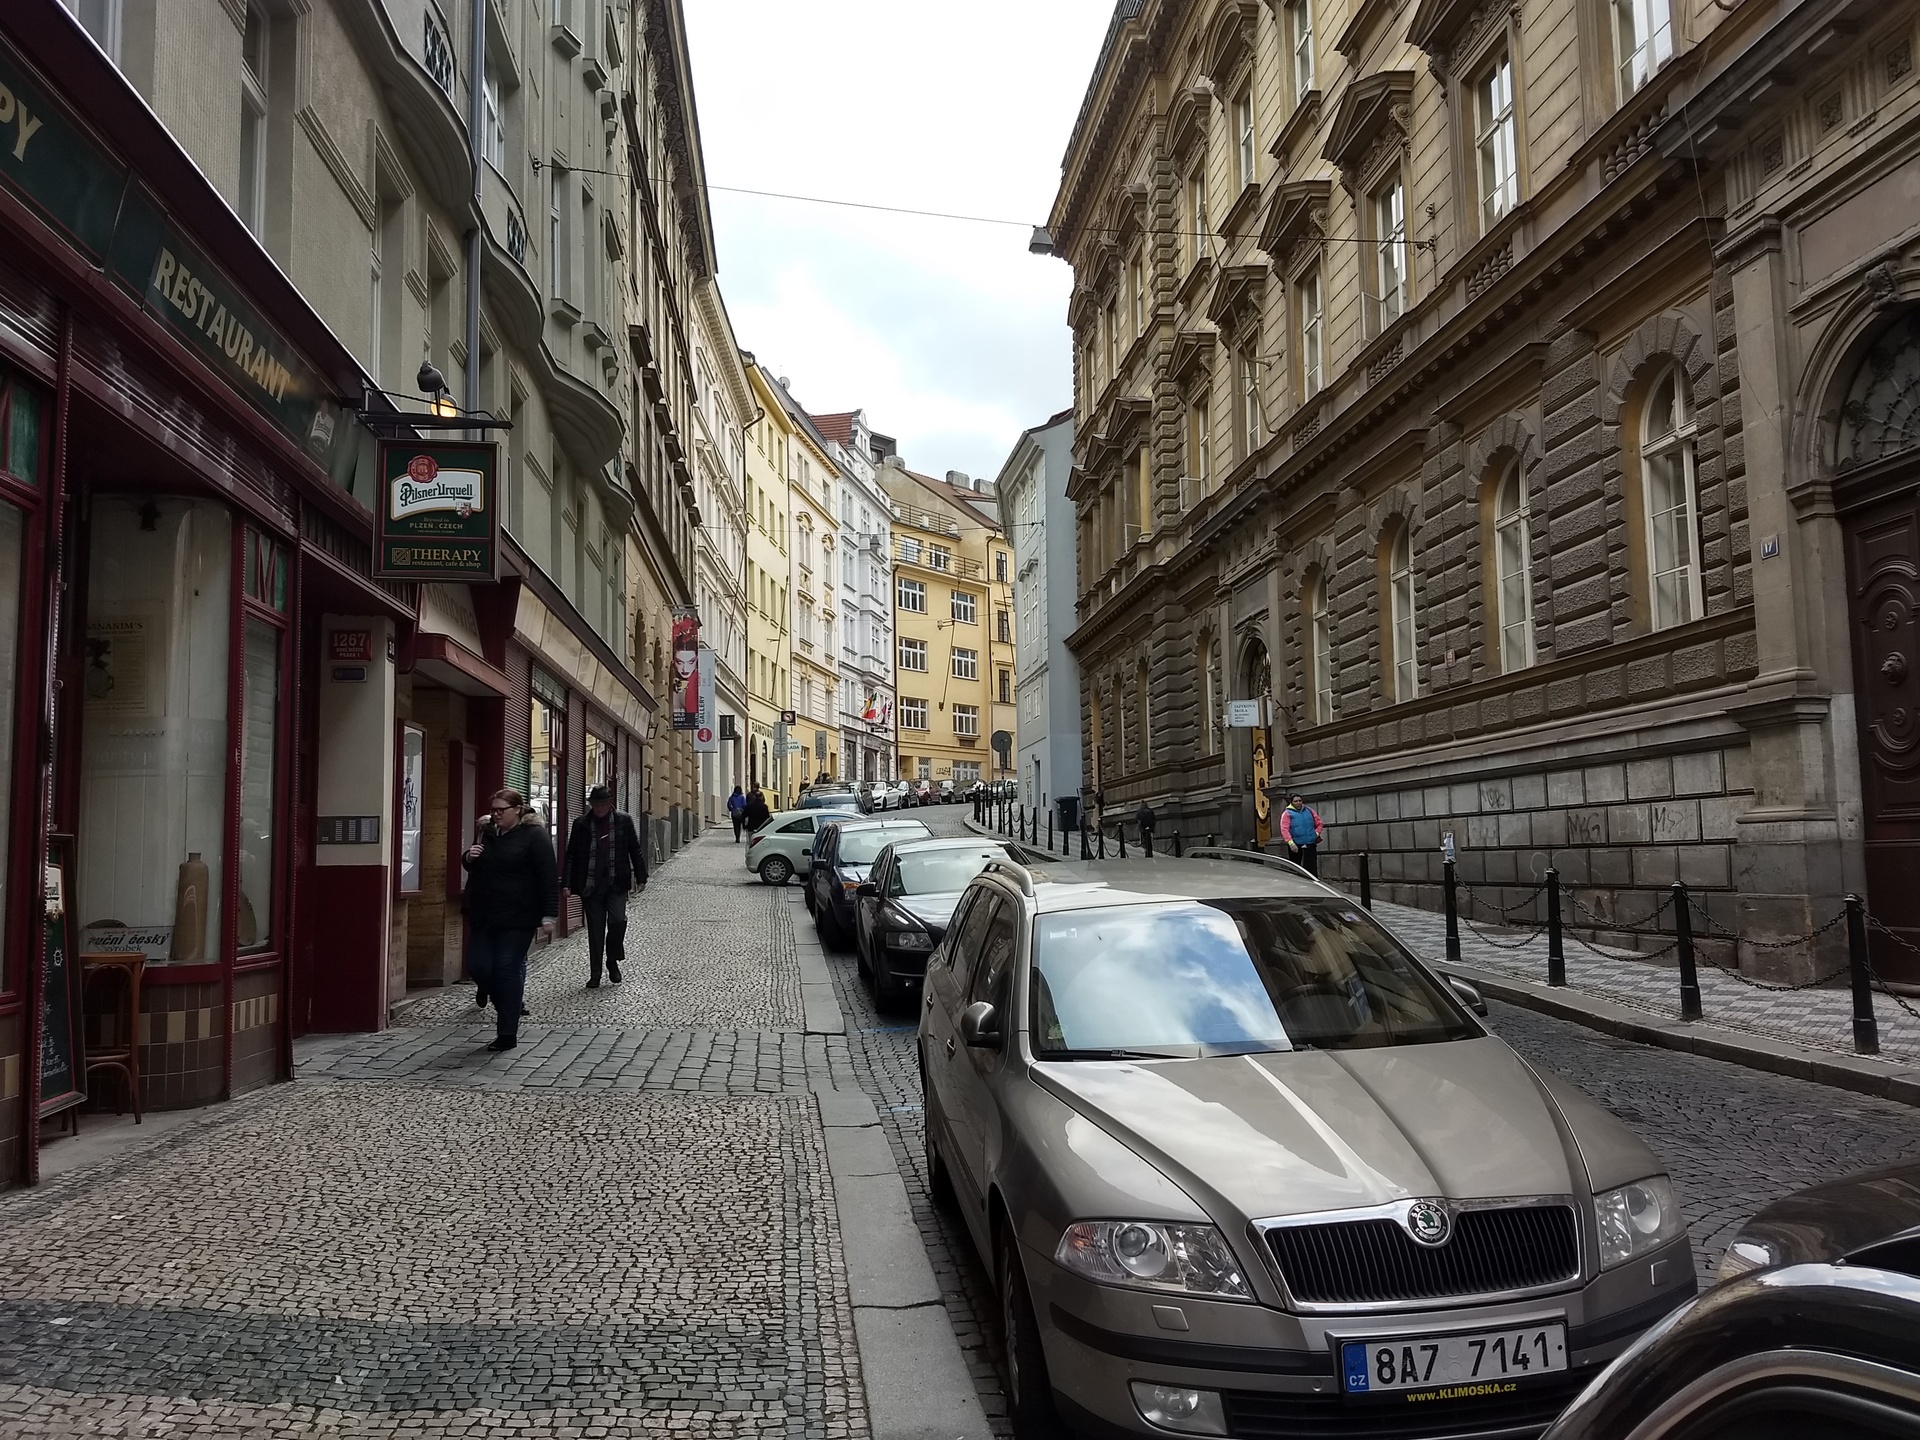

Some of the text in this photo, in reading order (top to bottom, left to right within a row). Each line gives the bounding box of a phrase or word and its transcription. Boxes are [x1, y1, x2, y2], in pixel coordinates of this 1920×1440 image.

[153, 246, 291, 404] RESTAURANT
[400, 482, 473, 507] Pilsner Urquell
[1764, 540, 1773, 553] 17
[411, 548, 482, 561] THERAPY
[333, 633, 367, 647] 1267
[128, 932, 170, 946] český
[1375, 1331, 1549, 1385] 8A7 7141
[1349, 1374, 1366, 1387] CZ
[1406, 1383, 1517, 1402] www.KLIMOSKA.cz
